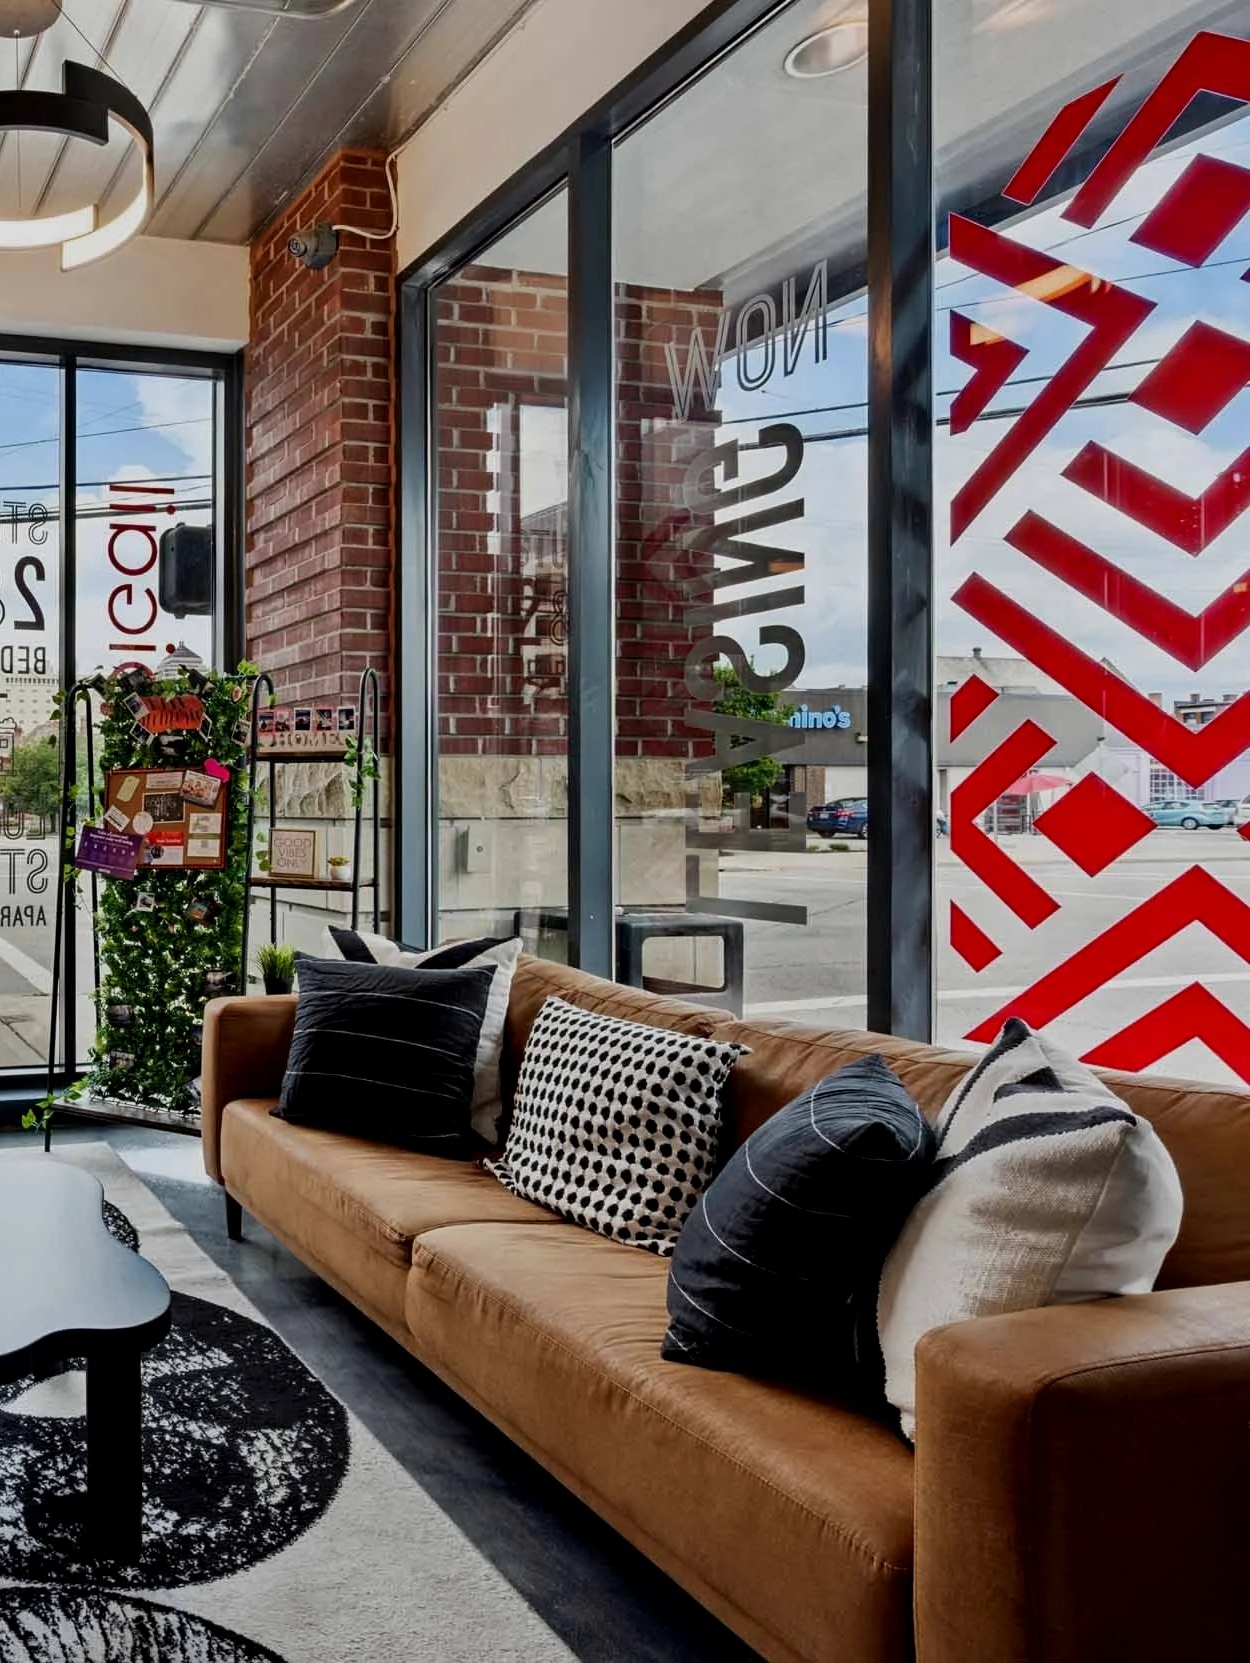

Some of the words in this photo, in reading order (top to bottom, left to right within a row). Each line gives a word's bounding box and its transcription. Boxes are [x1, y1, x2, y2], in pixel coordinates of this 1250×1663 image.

[273, 837, 312, 848] GOOD
[278, 848, 307, 858] VIBES
[277, 858, 307, 869] ONLY
